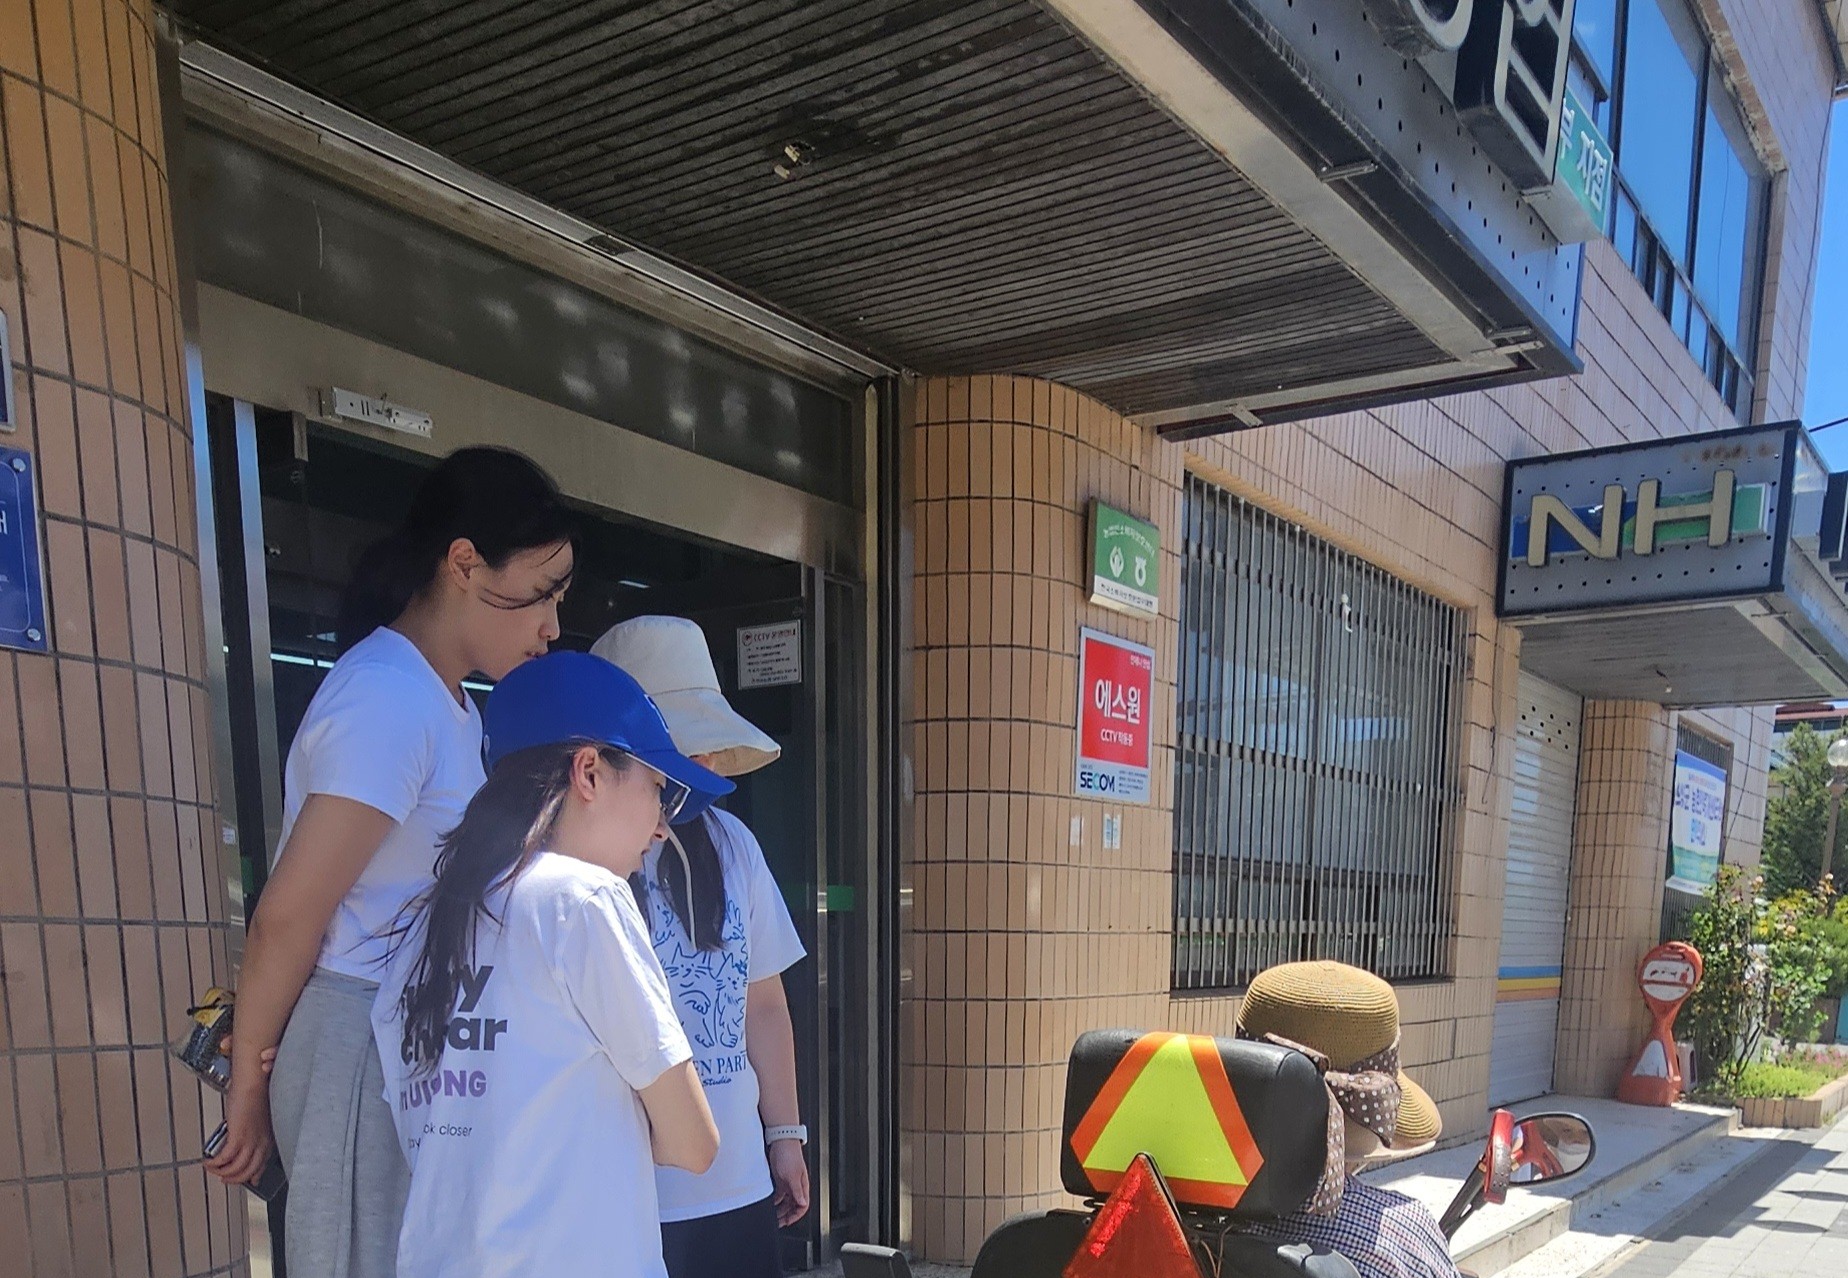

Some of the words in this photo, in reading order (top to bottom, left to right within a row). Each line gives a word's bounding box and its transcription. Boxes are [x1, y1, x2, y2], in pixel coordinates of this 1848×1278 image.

[1576, 130, 1609, 212] 지점
[1527, 469, 1736, 567] NH
[1095, 678, 1141, 724] 에스원
[1080, 770, 1116, 793] SECOM
[439, 1123, 472, 1137] closer
